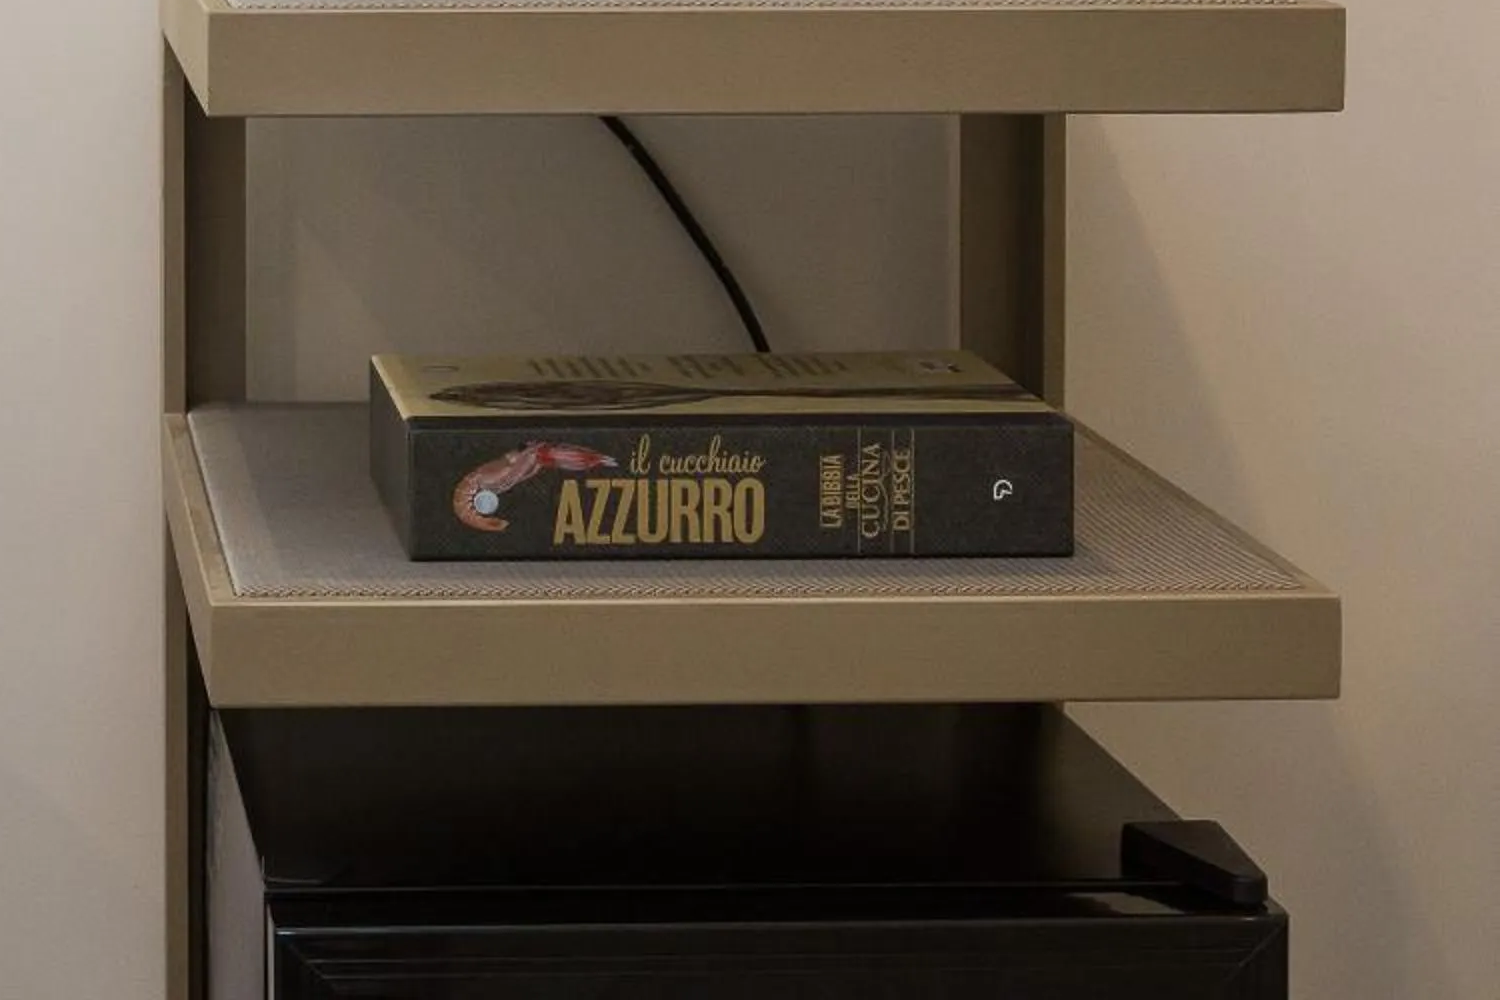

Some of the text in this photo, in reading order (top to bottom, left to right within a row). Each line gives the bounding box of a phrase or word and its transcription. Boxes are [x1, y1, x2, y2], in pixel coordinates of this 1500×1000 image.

[629, 433, 767, 475] il cucchiaio
[819, 454, 843, 507] BIBBIA
[553, 477, 766, 546] AZZURRO
[845, 473, 861, 509] DELLA
[861, 442, 881, 539] CUCINA
[892, 449, 911, 531] DI PESCE
